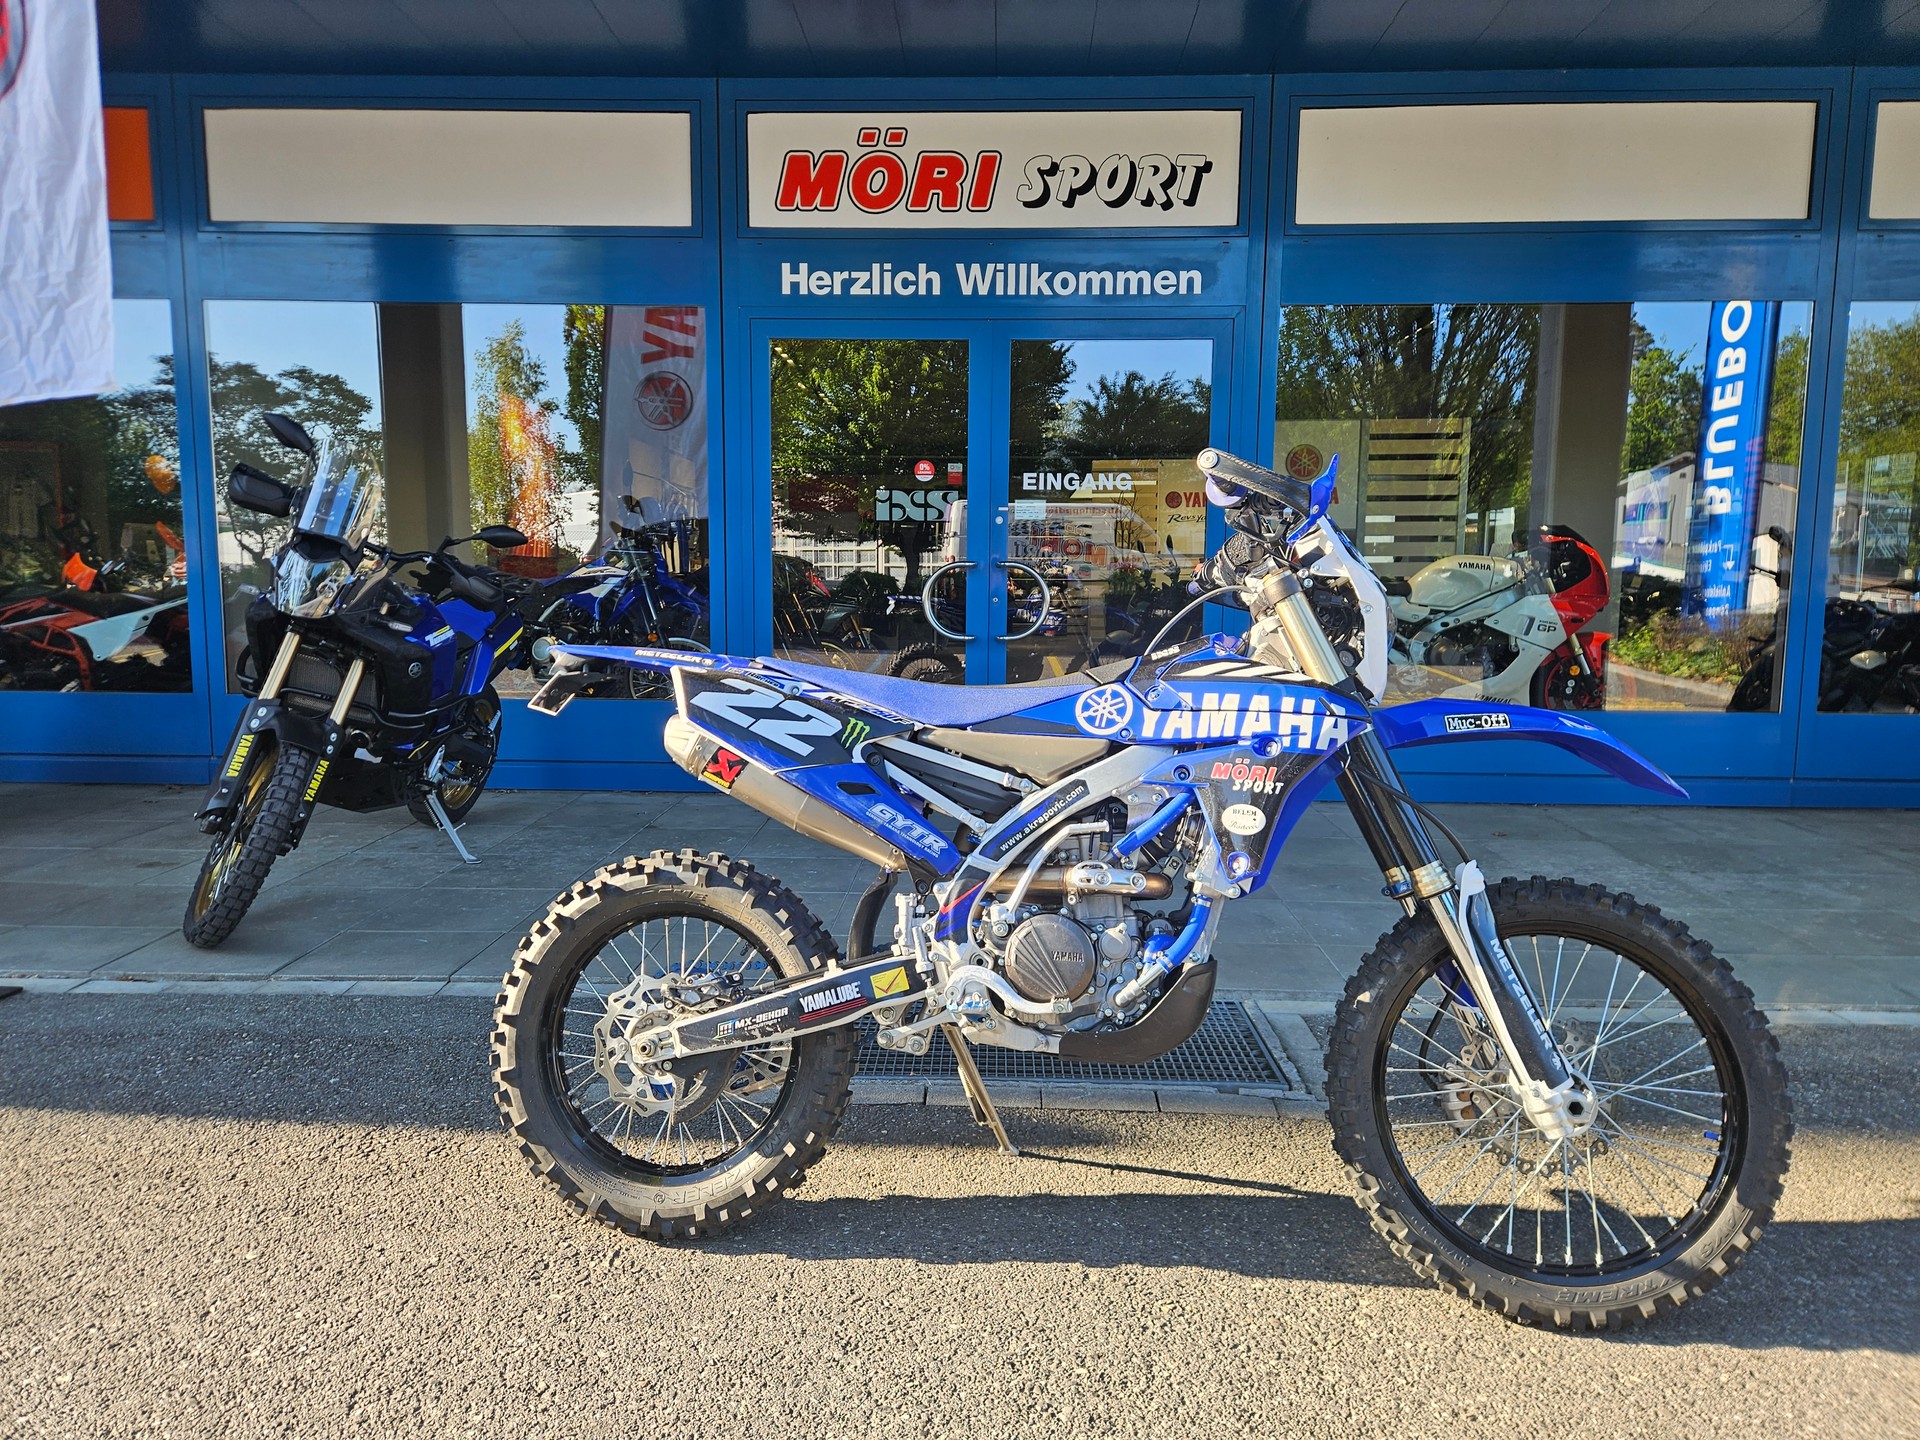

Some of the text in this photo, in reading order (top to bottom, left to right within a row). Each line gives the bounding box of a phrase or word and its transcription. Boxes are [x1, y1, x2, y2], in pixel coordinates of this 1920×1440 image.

[776, 127, 1213, 214] MÖRI SPORT
[781, 262, 1202, 296] Herzlich Willkommen
[1022, 472, 1133, 490] EINGANG
[1458, 561, 1491, 571] YAMAHA
[1537, 624, 1557, 633] GP
[690, 678, 843, 757] 22
[1141, 692, 1348, 751] YAMAHA
[1448, 715, 1508, 730] Muc-Off
[226, 734, 255, 777] YAMAHA
[1211, 757, 1278, 783] MÖRI
[304, 759, 330, 802] YAMAHA
[1232, 779, 1284, 795] SPORT
[867, 802, 948, 855] GYTR
[1000, 784, 1085, 852] www.akrapovic.com
[1052, 950, 1084, 963] YAMAHA
[800, 981, 861, 1012] YAMALUBE
[1490, 937, 1553, 1050] METZELER
